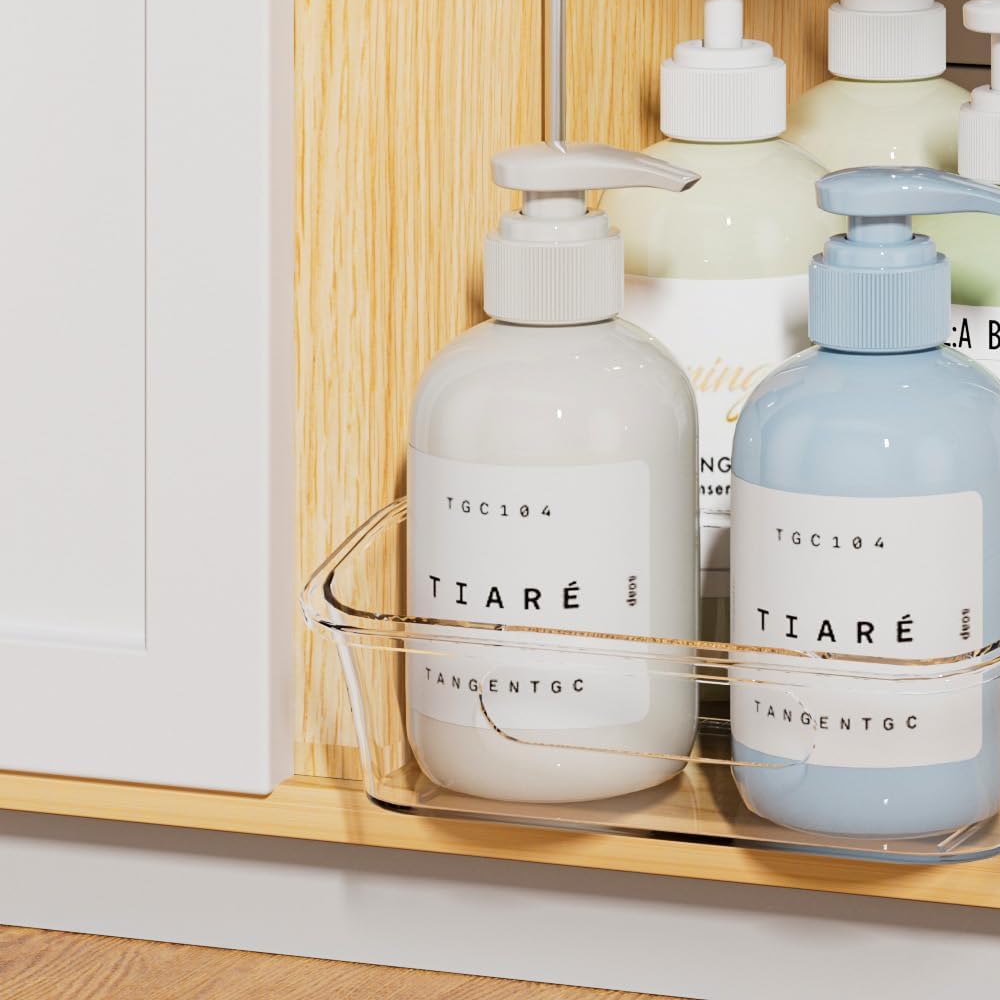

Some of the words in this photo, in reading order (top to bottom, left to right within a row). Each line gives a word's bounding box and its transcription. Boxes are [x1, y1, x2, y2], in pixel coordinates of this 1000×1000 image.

[429, 575, 580, 610] TIARÉ
[626, 575, 637, 607] soap
[757, 607, 914, 644] TIARÉ
[960, 608, 970, 640] soap
